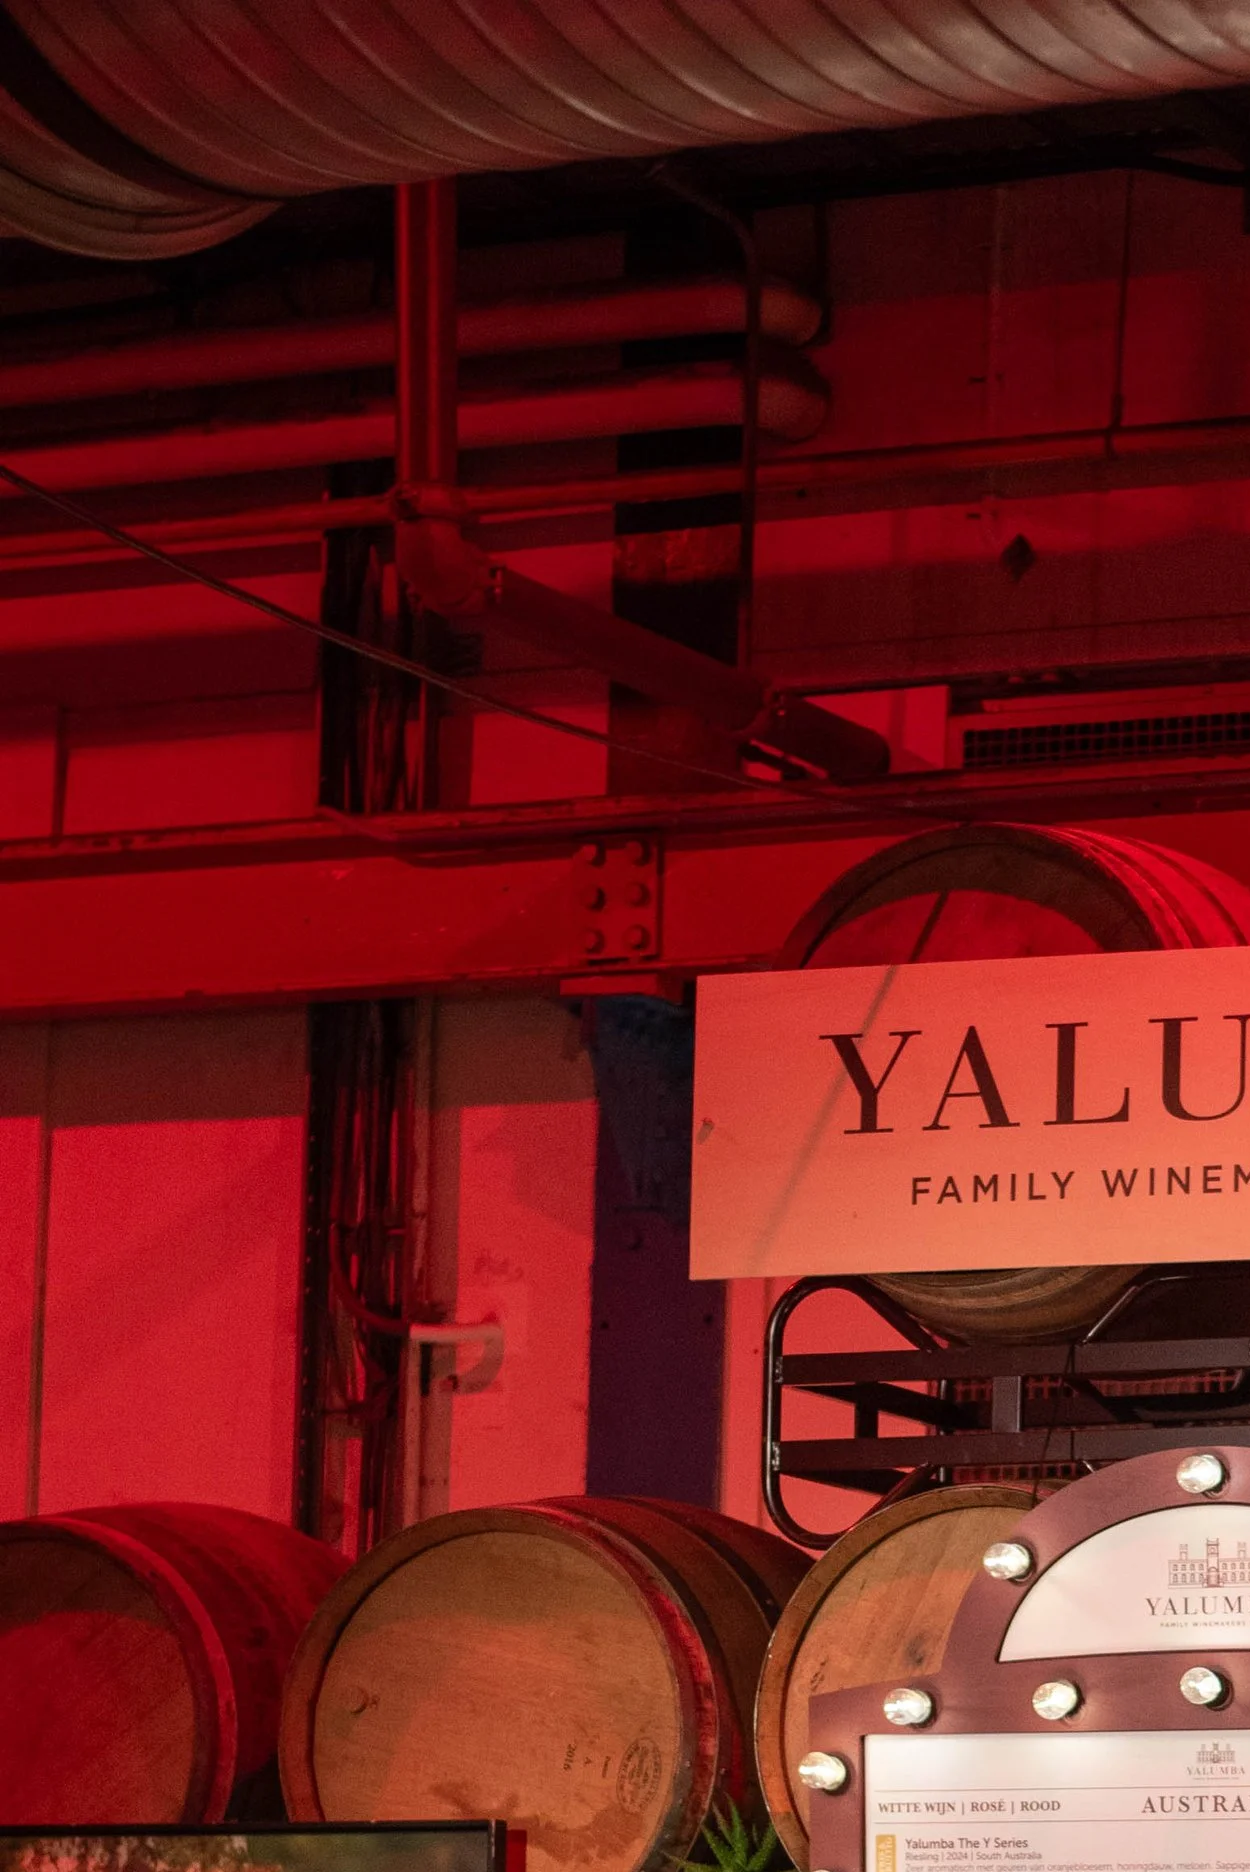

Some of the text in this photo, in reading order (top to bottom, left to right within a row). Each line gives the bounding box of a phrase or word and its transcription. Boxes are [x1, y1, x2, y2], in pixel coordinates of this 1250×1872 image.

[912, 1171, 1074, 1205] FAMILY
[1187, 1766, 1246, 1776] YALUMBA
[878, 1801, 1060, 1814] WITTE WIJN ROSÉ ROOD
[906, 1837, 1028, 1849] Yalumba The Y Series
[904, 1850, 1042, 1862] Riesling 2024 South Australia
